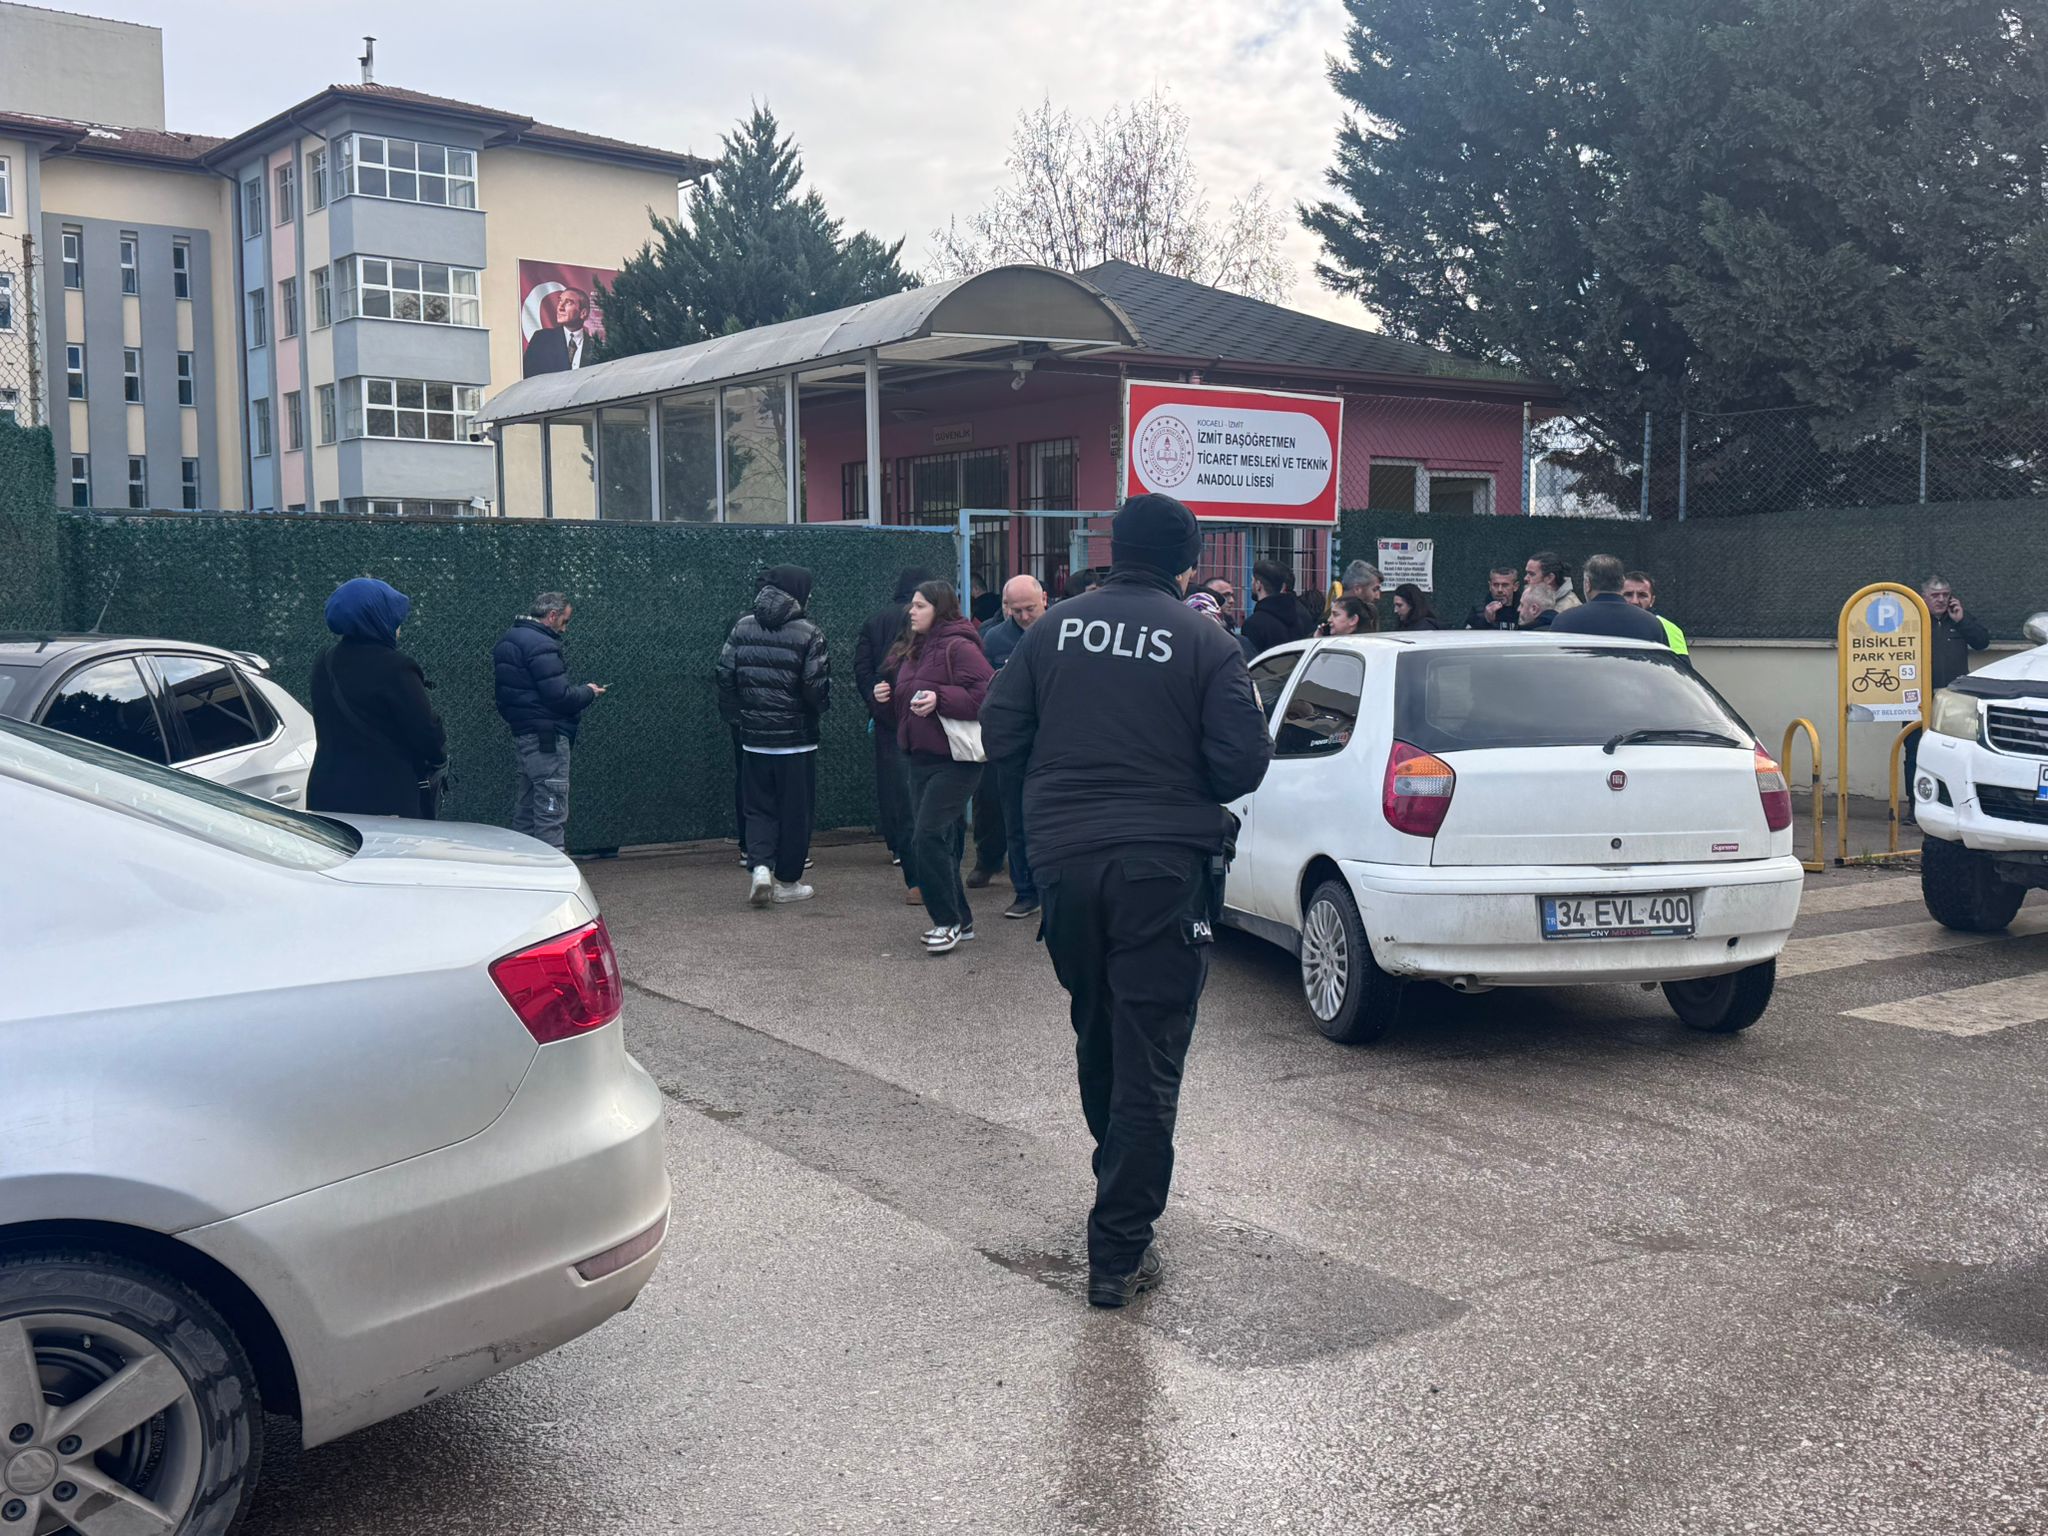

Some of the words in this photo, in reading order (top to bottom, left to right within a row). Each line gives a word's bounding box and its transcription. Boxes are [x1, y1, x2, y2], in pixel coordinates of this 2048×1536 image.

[1197, 429, 1223, 444] İZMİT
[1225, 431, 1296, 449] BAŞÖĞRETMEN
[1197, 450, 1238, 466] TİCARET
[1240, 454, 1281, 468] MESLEKİ
[1282, 457, 1294, 469] VE
[1296, 456, 1328, 471] TEKNİK
[1196, 473, 1244, 487] ANADOLU
[1246, 472, 1274, 488] LİSESİ
[1877, 604, 1896, 627] P
[1852, 635, 1916, 648] BİSİKLET
[1852, 651, 1885, 662] PARK
[1888, 650, 1916, 661] YERİ
[1901, 667, 1914, 676] 53
[1558, 901, 1586, 927] 34
[1595, 899, 1644, 926] EVL
[1649, 898, 1689, 924] 400
[1590, 930, 1609, 938] CNY
[1611, 928, 1651, 937] MOTORS
